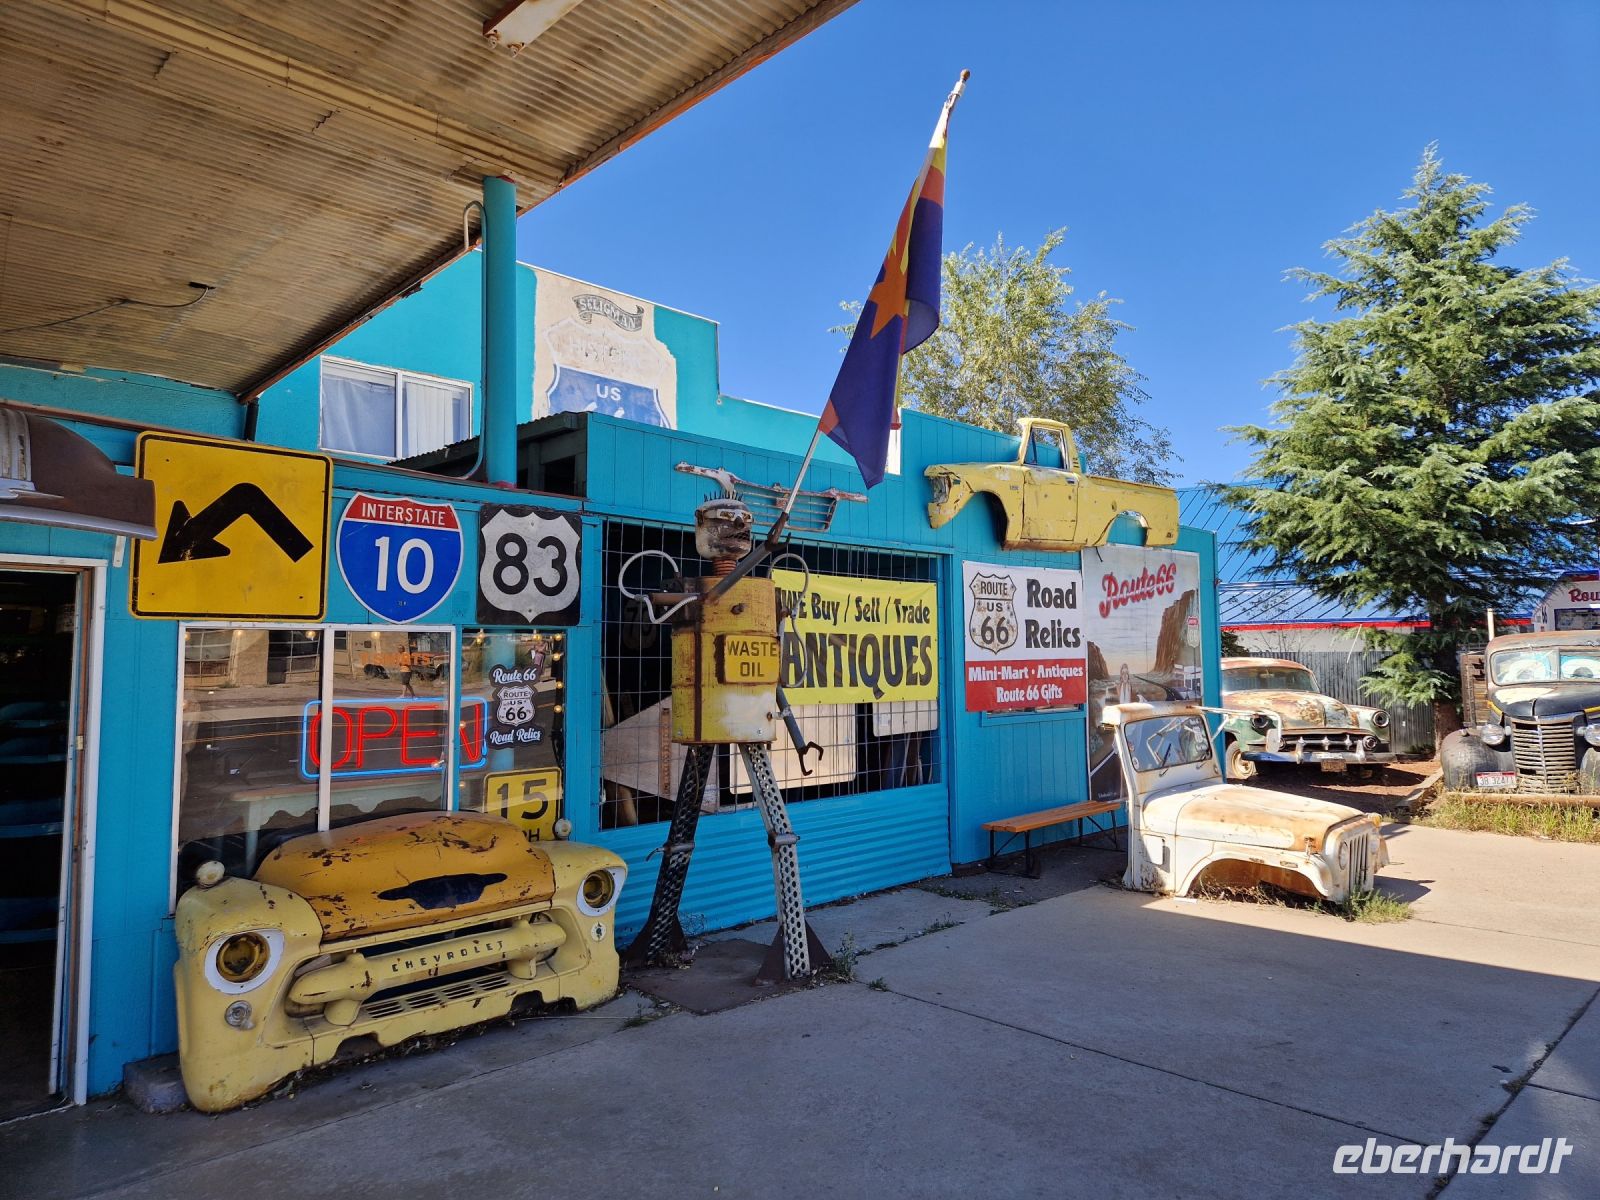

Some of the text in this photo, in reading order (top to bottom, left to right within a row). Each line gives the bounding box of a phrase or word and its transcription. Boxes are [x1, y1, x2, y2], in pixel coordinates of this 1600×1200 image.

[579, 298, 637, 330] SELIGMAN
[596, 383, 622, 401] US
[361, 502, 446, 527] INTERSTATE
[374, 535, 434, 595] 10
[492, 532, 568, 597] 83
[980, 581, 1008, 596] ROUTE
[1026, 578, 1077, 609] Road
[811, 592, 840, 626] Buy
[844, 593, 851, 623] /
[855, 596, 880, 623] Sell
[884, 596, 891, 624] /
[893, 598, 930, 625] Trade
[986, 602, 1003, 612] US
[980, 616, 1009, 645] 66
[1025, 619, 1081, 649] Relics
[727, 639, 778, 657] WASTE
[492, 667, 537, 684] Route 66
[739, 661, 765, 678] OIL
[781, 631, 933, 700] ANTIQUES
[968, 664, 1083, 682] Mini-Mart Antiques
[503, 691, 529, 699] ROUTE
[996, 684, 1063, 703] Route 66 Gifts
[505, 706, 527, 721] 66
[309, 703, 481, 769] OPEN
[489, 727, 542, 745] Road Relics
[496, 778, 548, 820] 15
[391, 940, 503, 973] CHEVROLET
